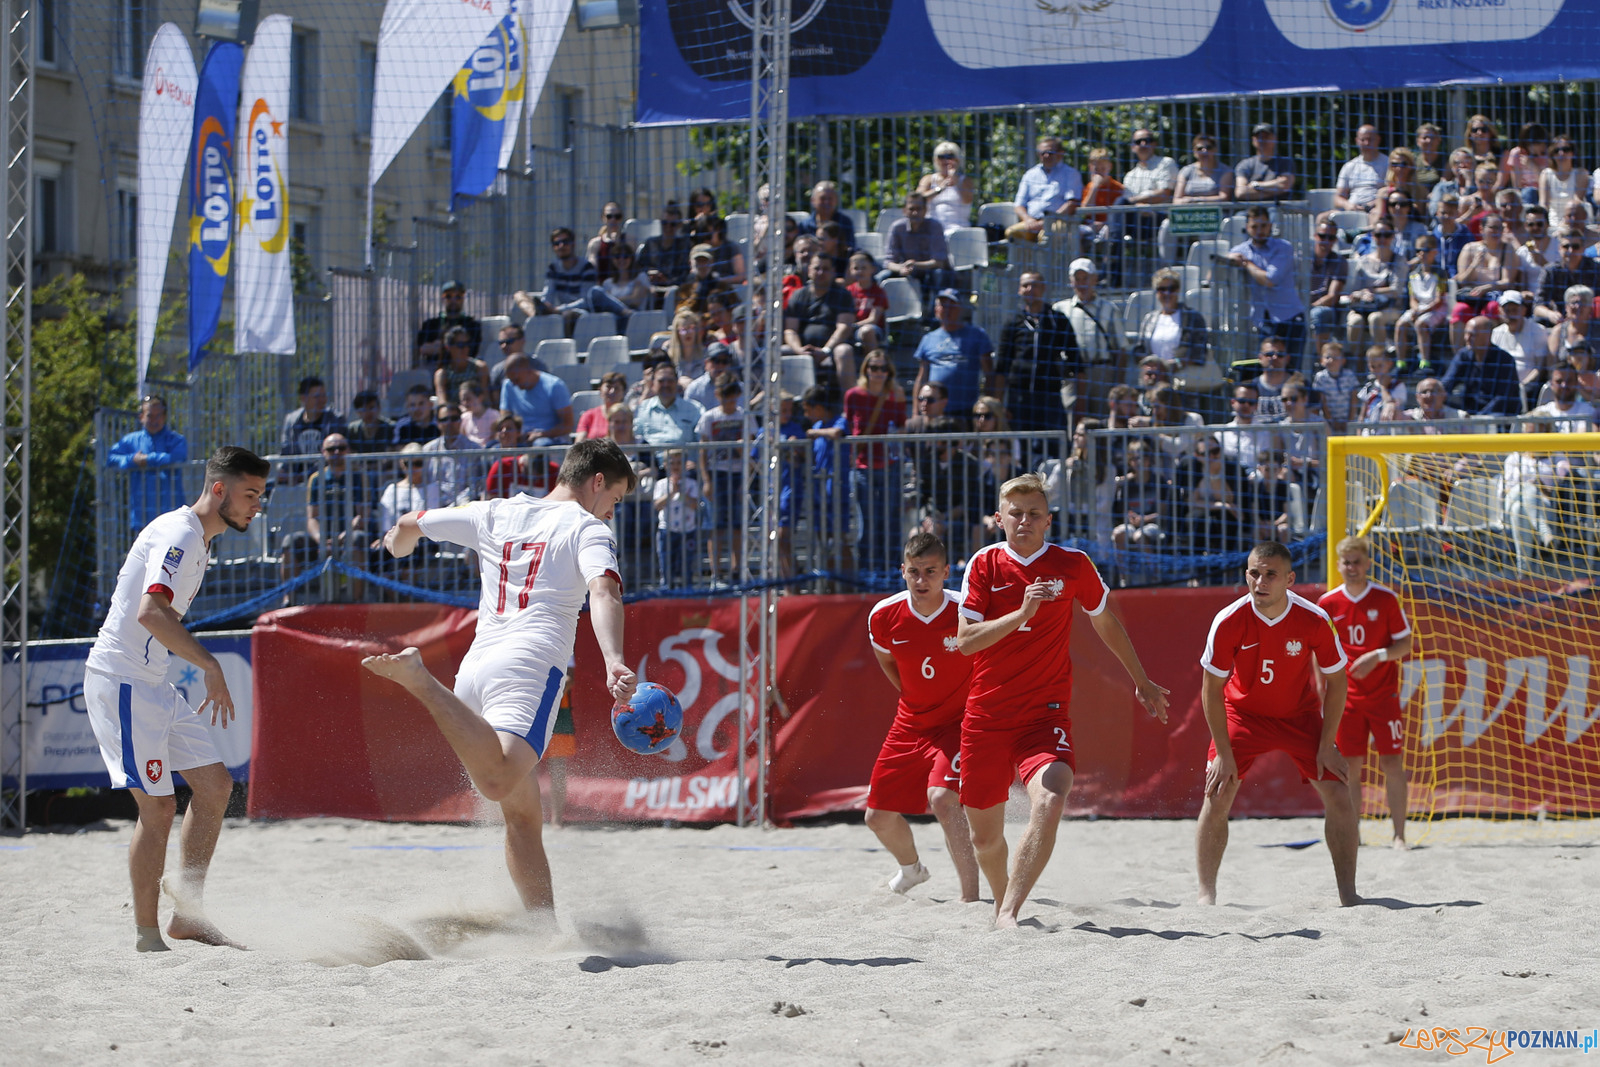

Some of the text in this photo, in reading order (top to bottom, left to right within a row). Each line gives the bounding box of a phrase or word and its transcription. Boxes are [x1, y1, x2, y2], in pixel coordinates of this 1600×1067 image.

[256, 129, 277, 220] LOTTO
[202, 146, 229, 241] LOTTO
[495, 541, 547, 615] 17
[1347, 624, 1366, 645] 10
[921, 656, 935, 679] 6
[1260, 659, 1275, 685] 5
[1053, 727, 1070, 747] 2
[1388, 720, 1402, 740] 10
[951, 752, 961, 773] 6
